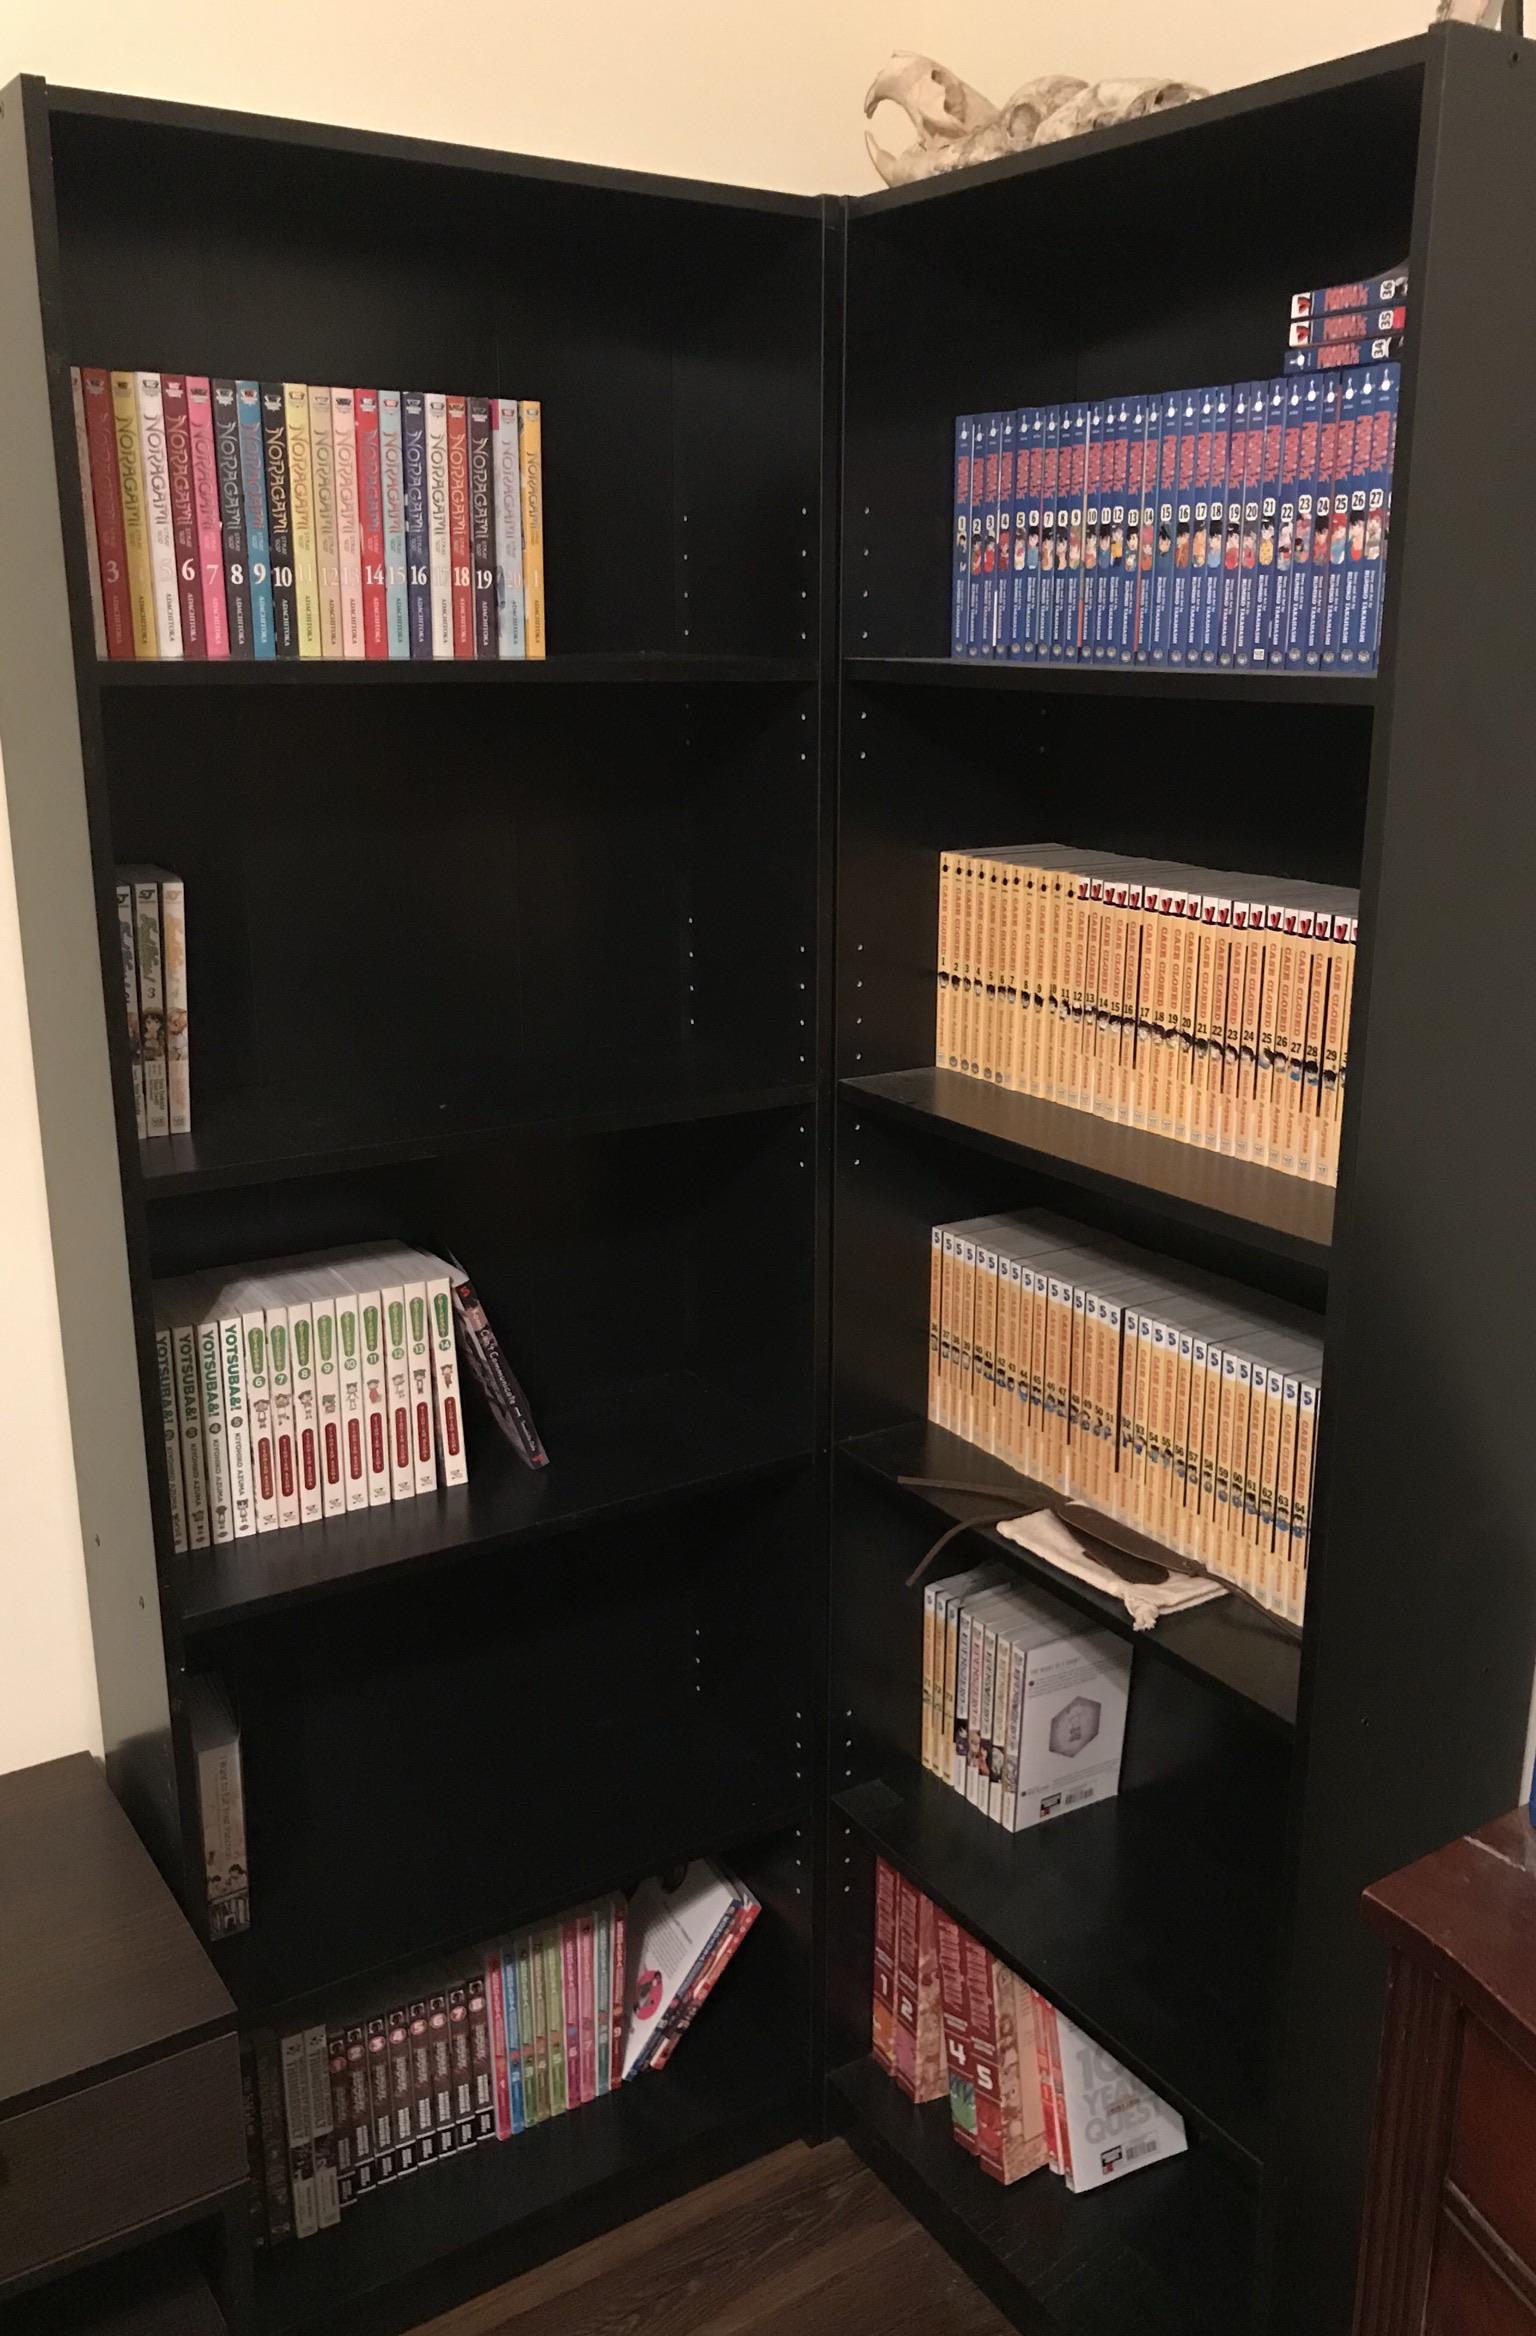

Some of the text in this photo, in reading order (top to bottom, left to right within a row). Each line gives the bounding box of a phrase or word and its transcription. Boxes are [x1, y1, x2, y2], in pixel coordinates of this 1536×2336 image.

[1382, 281, 1394, 298] 36
[1380, 311, 1392, 328] 35
[1373, 342, 1384, 357] 34
[144, 414, 174, 525] NORAGAMI
[168, 415, 193, 525] NORAGAMI
[218, 422, 242, 529] NORAGAMI
[266, 427, 288, 533] NORAGAMI
[406, 430, 424, 533] NORAGAMI
[430, 434, 447, 535] NORAGAMI
[450, 433, 466, 535] NORAGAMI
[472, 437, 489, 539] NORAGAMI
[1299, 497, 1311, 511] 23
[1335, 497, 1347, 510] 25
[1352, 494, 1364, 508] 26
[1370, 491, 1382, 505] 27
[1161, 506, 1171, 519] 15
[1197, 504, 1206, 518] 17
[1212, 504, 1221, 518] 18
[1230, 506, 1240, 519] 19
[1247, 505, 1257, 518] 20
[1264, 500, 1275, 514] 21
[1282, 506, 1292, 520] 22
[1318, 499, 1329, 513] 24
[1114, 508, 1122, 520] 12
[1129, 512, 1138, 524] 13
[1180, 507, 1189, 520] 16
[106, 560, 119, 583] 3
[181, 558, 196, 581] 6
[205, 564, 219, 585] 7
[230, 563, 244, 585] 8
[253, 562, 266, 585] 9
[274, 565, 293, 587] 10
[366, 565, 385, 585] 14
[410, 565, 427, 586] 16
[454, 566, 470, 587] 18
[476, 570, 493, 590] 19
[147, 986, 156, 999] 3
[1061, 988, 1070, 999] 11
[1073, 991, 1082, 1002] 12
[1085, 993, 1095, 1003] 13
[1099, 998, 1108, 1007] 14
[1111, 1001, 1120, 1011] 15
[1124, 1004, 1134, 1015] 16
[1140, 1007, 1150, 1018] 17
[1155, 1011, 1165, 1022] 18
[1168, 1013, 1178, 1024] 19
[1181, 1017, 1191, 1028] 20
[1197, 1023, 1207, 1034] 21
[1211, 1025, 1222, 1036] 22
[1227, 1029, 1238, 1041] 23
[1243, 1030, 1254, 1041] 24
[1261, 1032, 1272, 1044] 25
[1276, 1035, 1287, 1047] 26
[1290, 1042, 1301, 1054] 27
[1306, 1045, 1318, 1057] 28
[1325, 1049, 1337, 1061] 29
[202, 1329, 219, 1417] YOTSUBA&!
[225, 1323, 242, 1411] YOTSUBA&!
[179, 1333, 198, 1421] YOTSUBA&!
[489, 1350, 516, 1405] Communicate
[1247, 1480, 1257, 1491] 61
[1262, 1488, 1272, 1499] 62
[1294, 1503, 1305, 1513] 64
[880, 1973, 887, 1996] 1
[901, 1996, 913, 2022] 2
[949, 2038, 966, 2066] 4
[976, 2063, 993, 2090] 5
